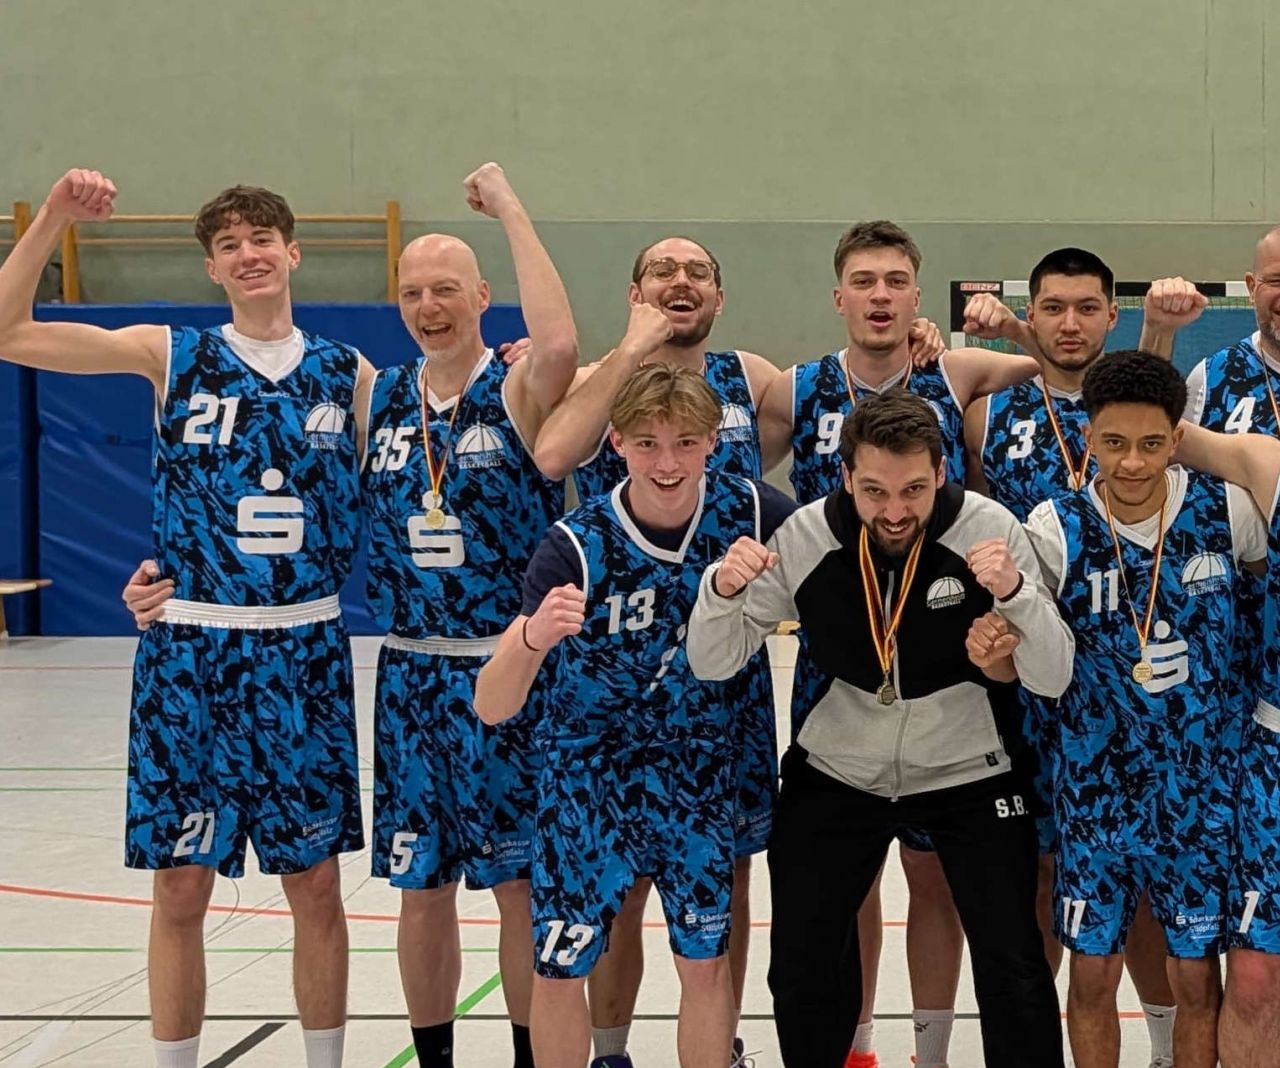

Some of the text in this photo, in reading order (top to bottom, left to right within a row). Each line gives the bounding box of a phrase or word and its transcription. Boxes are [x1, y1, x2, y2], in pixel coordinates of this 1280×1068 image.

[183, 393, 240, 445] 21
[815, 412, 845, 455] 9
[1224, 397, 1256, 434] 4
[371, 427, 416, 472] 35
[1007, 420, 1037, 460] 3
[605, 588, 656, 634] 13
[1087, 568, 1119, 614] 11
[995, 795, 1029, 818] S.B.
[173, 811, 215, 857] 21
[1063, 897, 1086, 939] 11
[1239, 891, 1260, 934] 1
[540, 920, 594, 966] 13
